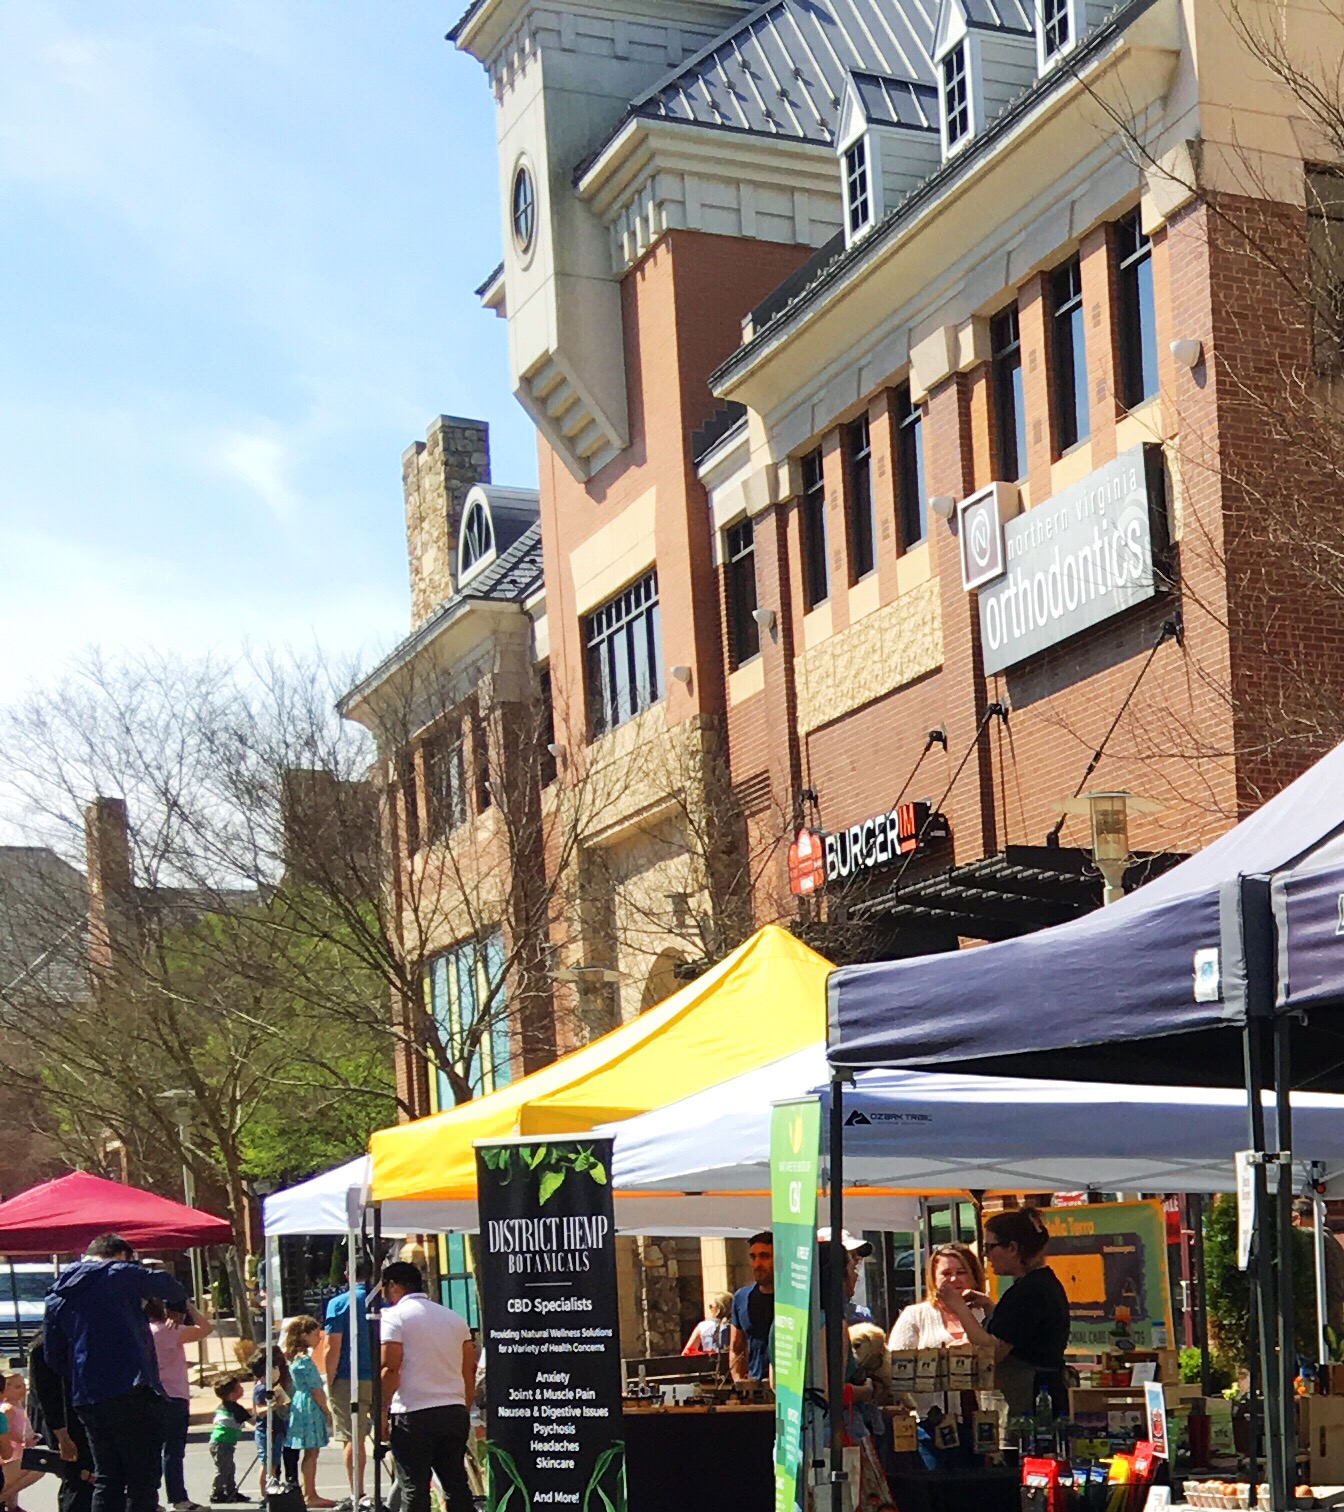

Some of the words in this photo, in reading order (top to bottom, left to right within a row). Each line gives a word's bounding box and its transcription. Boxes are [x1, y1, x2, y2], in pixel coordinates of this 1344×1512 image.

[1007, 506, 1069, 561] northern
[1076, 466, 1138, 520] virginia
[986, 518, 1144, 651] orthodontics
[488, 1217, 560, 1253] DISTRICT
[562, 1215, 608, 1250] HEMP
[508, 1251, 590, 1274] BOTANICALS
[507, 1298, 532, 1313] CBD
[533, 1297, 593, 1315] Specialists
[520, 1328, 550, 1339] Natural
[550, 1328, 581, 1338] Wellness
[581, 1327, 613, 1338] Solutions
[536, 1371, 570, 1386] Anxiety
[508, 1388, 534, 1400] Joint
[534, 1388, 542, 1400] &
[543, 1388, 575, 1400] Muscle
[575, 1387, 596, 1400] Pain
[497, 1406, 531, 1418] Nausea
[532, 1406, 540, 1418] &
[541, 1405, 582, 1419] Digestive
[582, 1406, 609, 1418] Issues
[533, 1422, 576, 1437] Psychosis
[530, 1440, 580, 1452] Headaches
[536, 1456, 576, 1470] Skincare
[533, 1491, 553, 1504] And
[554, 1491, 580, 1504] More!
